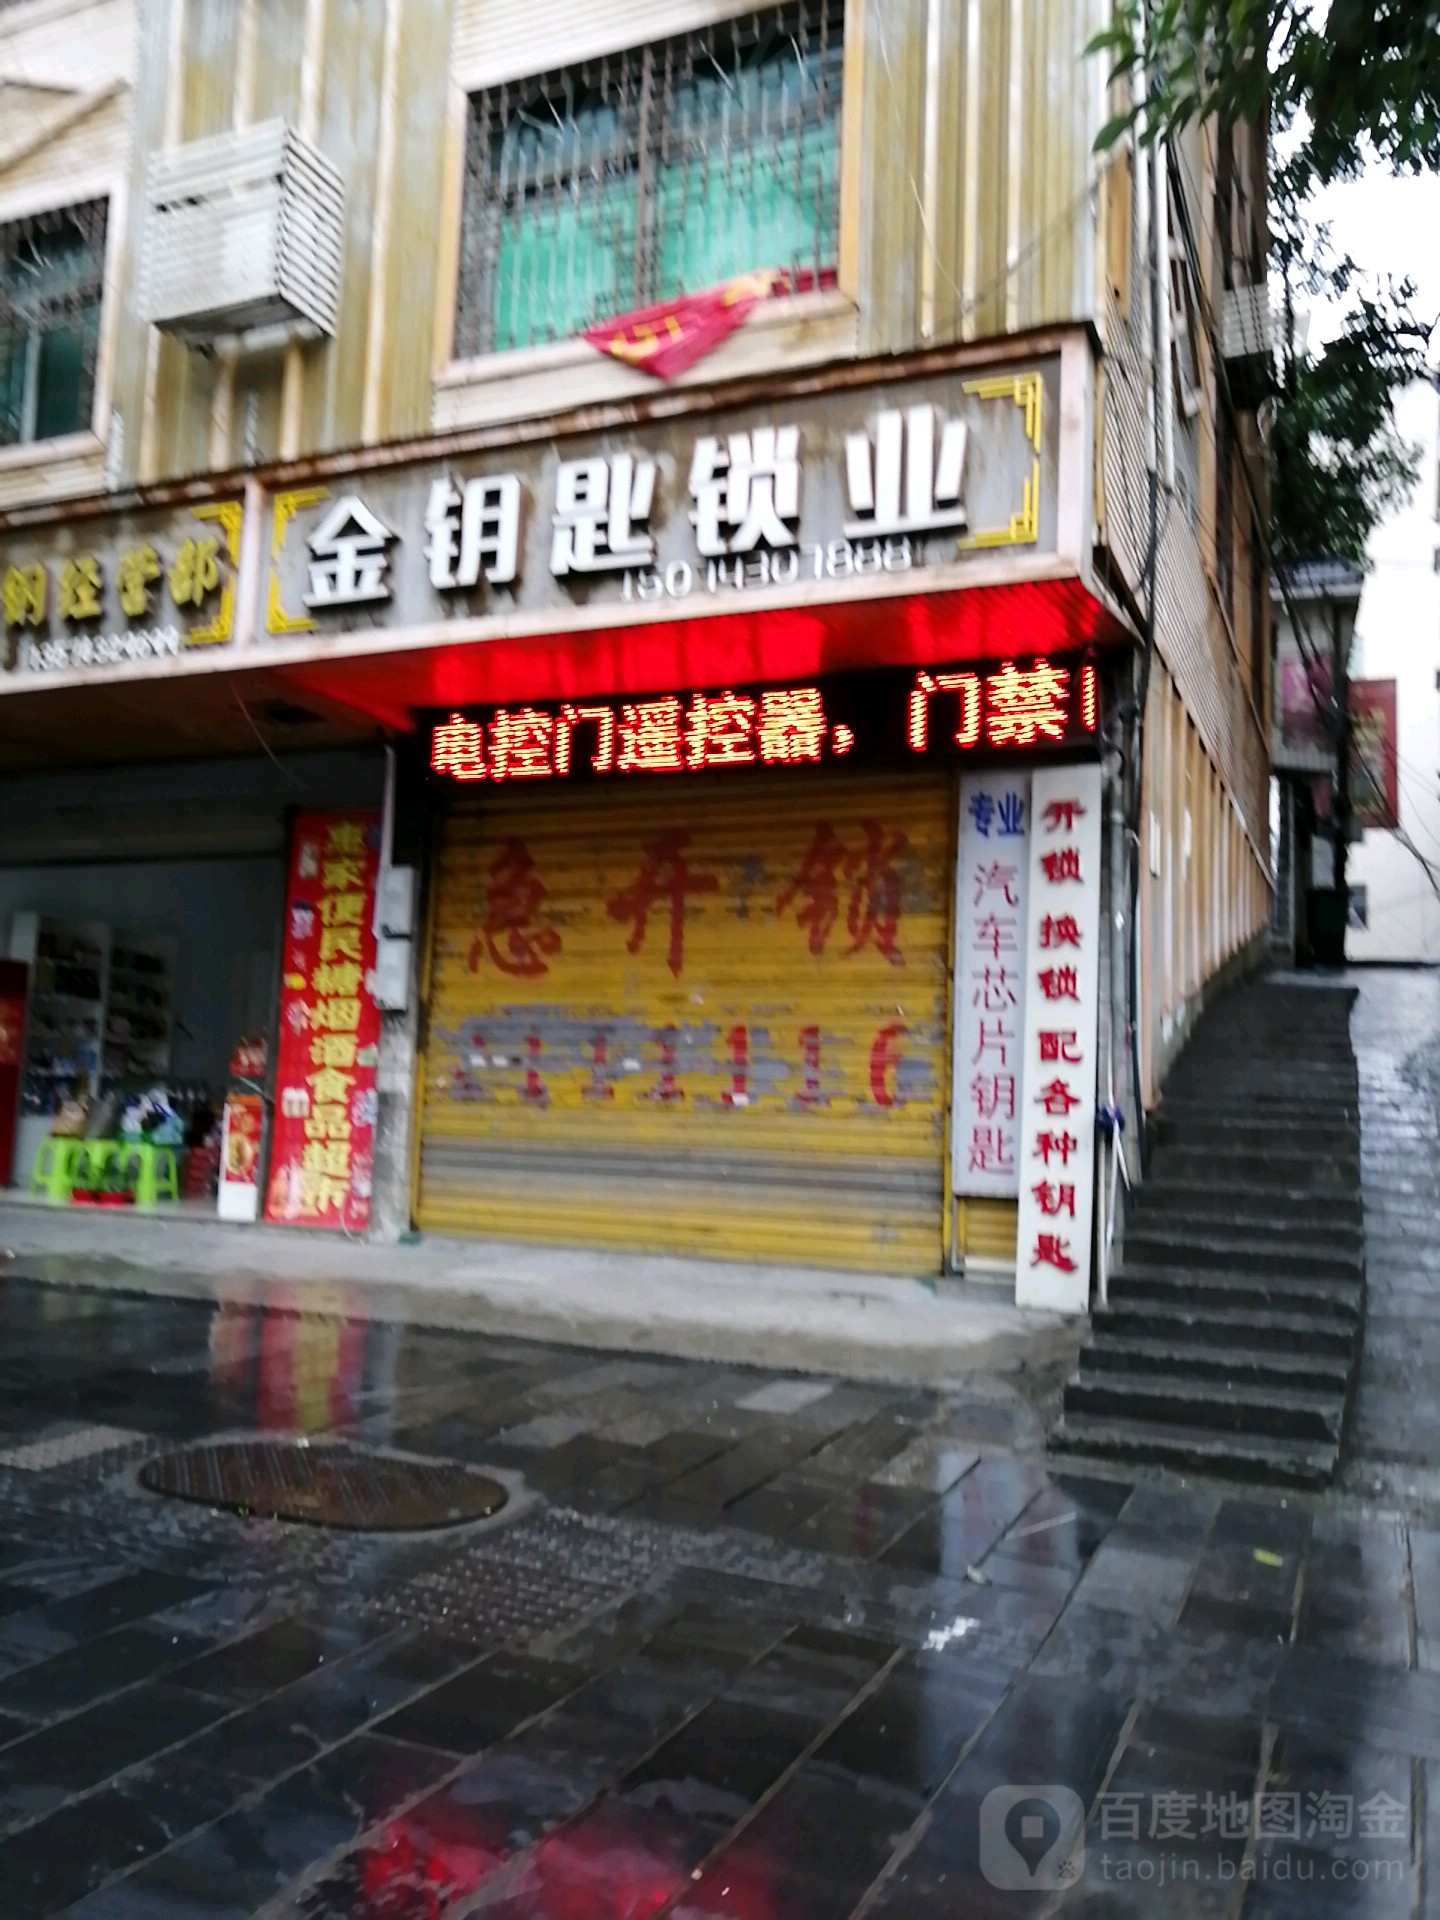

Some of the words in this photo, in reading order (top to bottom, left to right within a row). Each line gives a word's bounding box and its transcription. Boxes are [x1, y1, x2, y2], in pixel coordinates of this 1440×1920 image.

[303, 404, 968, 608] 金钥匙锁业
[431, 688, 855, 782] 电控门遥控器，
[906, 658, 1097, 751] 门禁
[968, 790, 1025, 838] 专业
[468, 818, 907, 978] 急开锁
[967, 859, 1019, 1176] 汽车芯片钥匙
[1030, 798, 1086, 1273] 开锁换锁配各种钥匙
